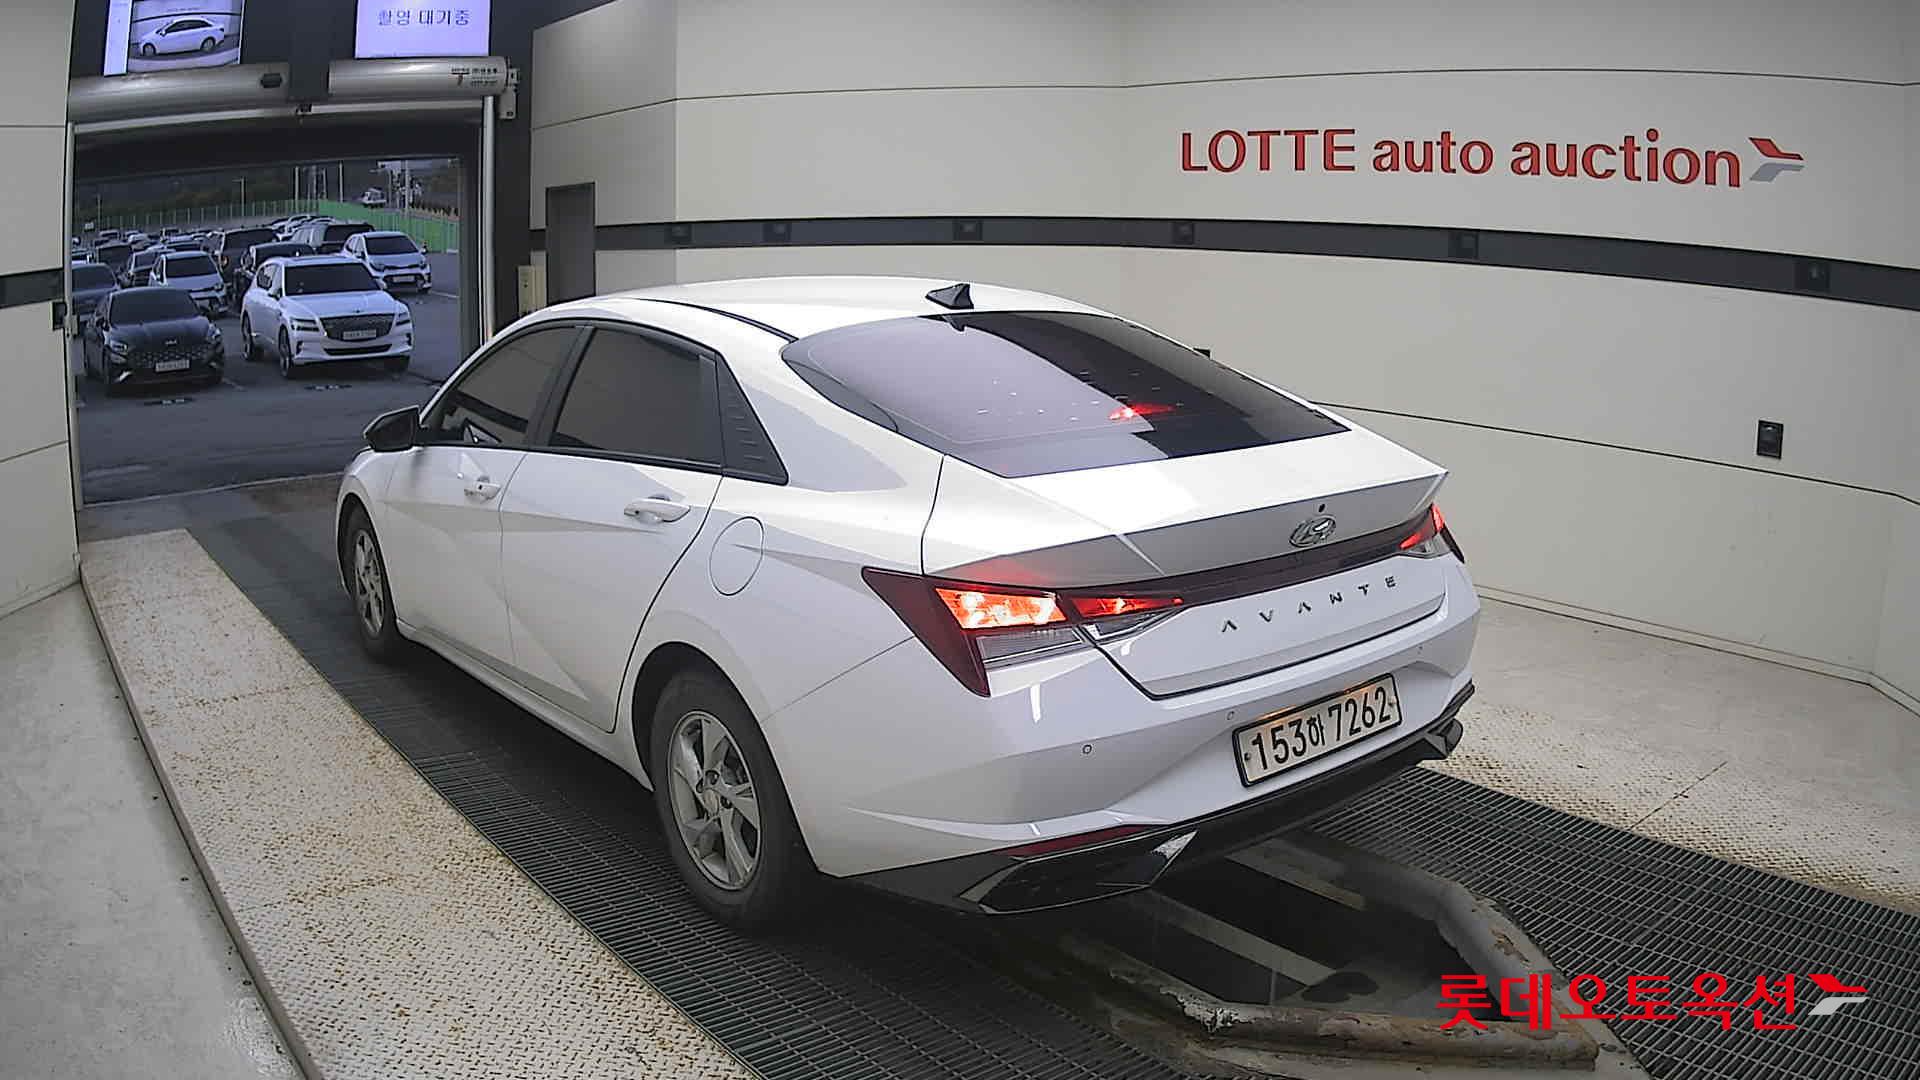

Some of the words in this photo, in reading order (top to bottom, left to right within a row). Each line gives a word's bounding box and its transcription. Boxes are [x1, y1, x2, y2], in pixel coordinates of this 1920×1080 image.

[418, 9, 469, 26] 대기중
[1181, 129, 1356, 172] LOTTE
[1372, 131, 1494, 174] auto
[1511, 128, 1742, 188] auction
[1221, 575, 1397, 633] AVANTE
[1328, 686, 1391, 742] 7262
